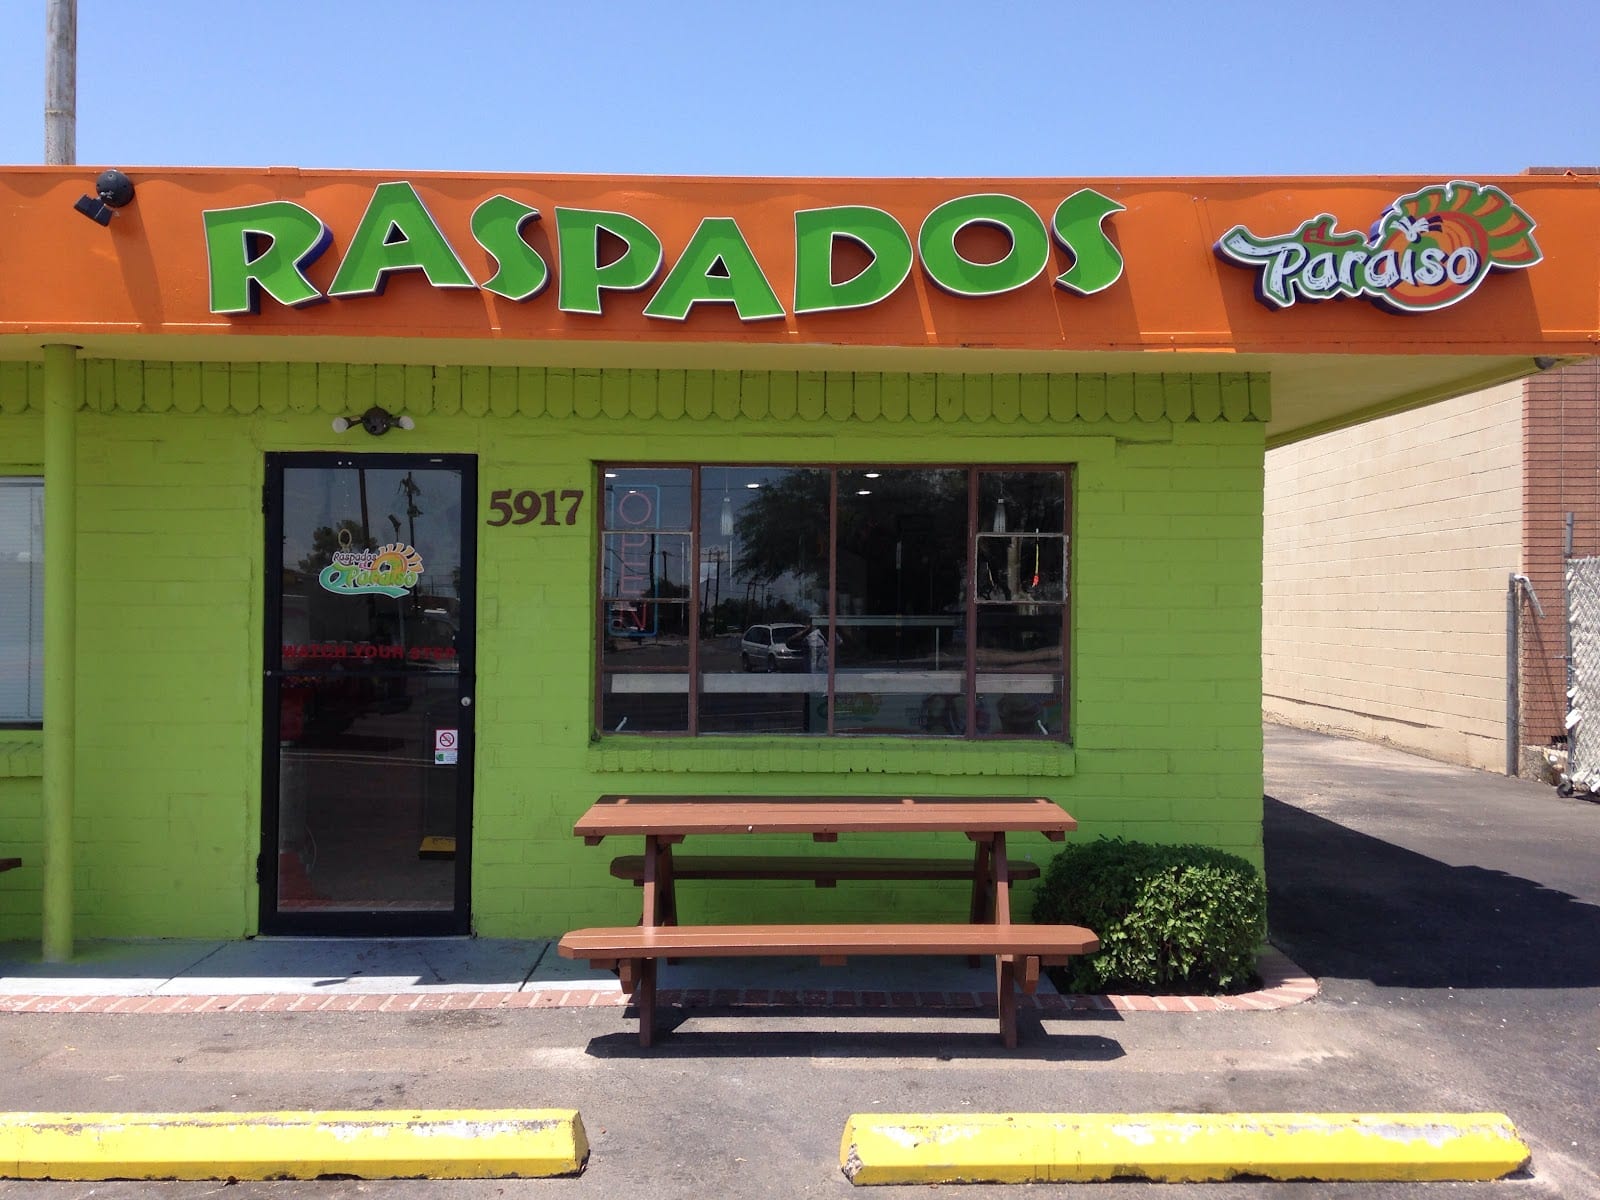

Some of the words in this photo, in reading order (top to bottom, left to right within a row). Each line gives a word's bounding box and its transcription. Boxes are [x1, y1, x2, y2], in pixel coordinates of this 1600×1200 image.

[203, 181, 1126, 321] RASPADOS
[1225, 233, 1482, 301] Paraiso
[486, 488, 584, 526] 5917
[332, 548, 376, 566] Raspados
[282, 644, 348, 657] WATCH
[352, 644, 404, 659] YOUR
[409, 645, 457, 660] STEP
